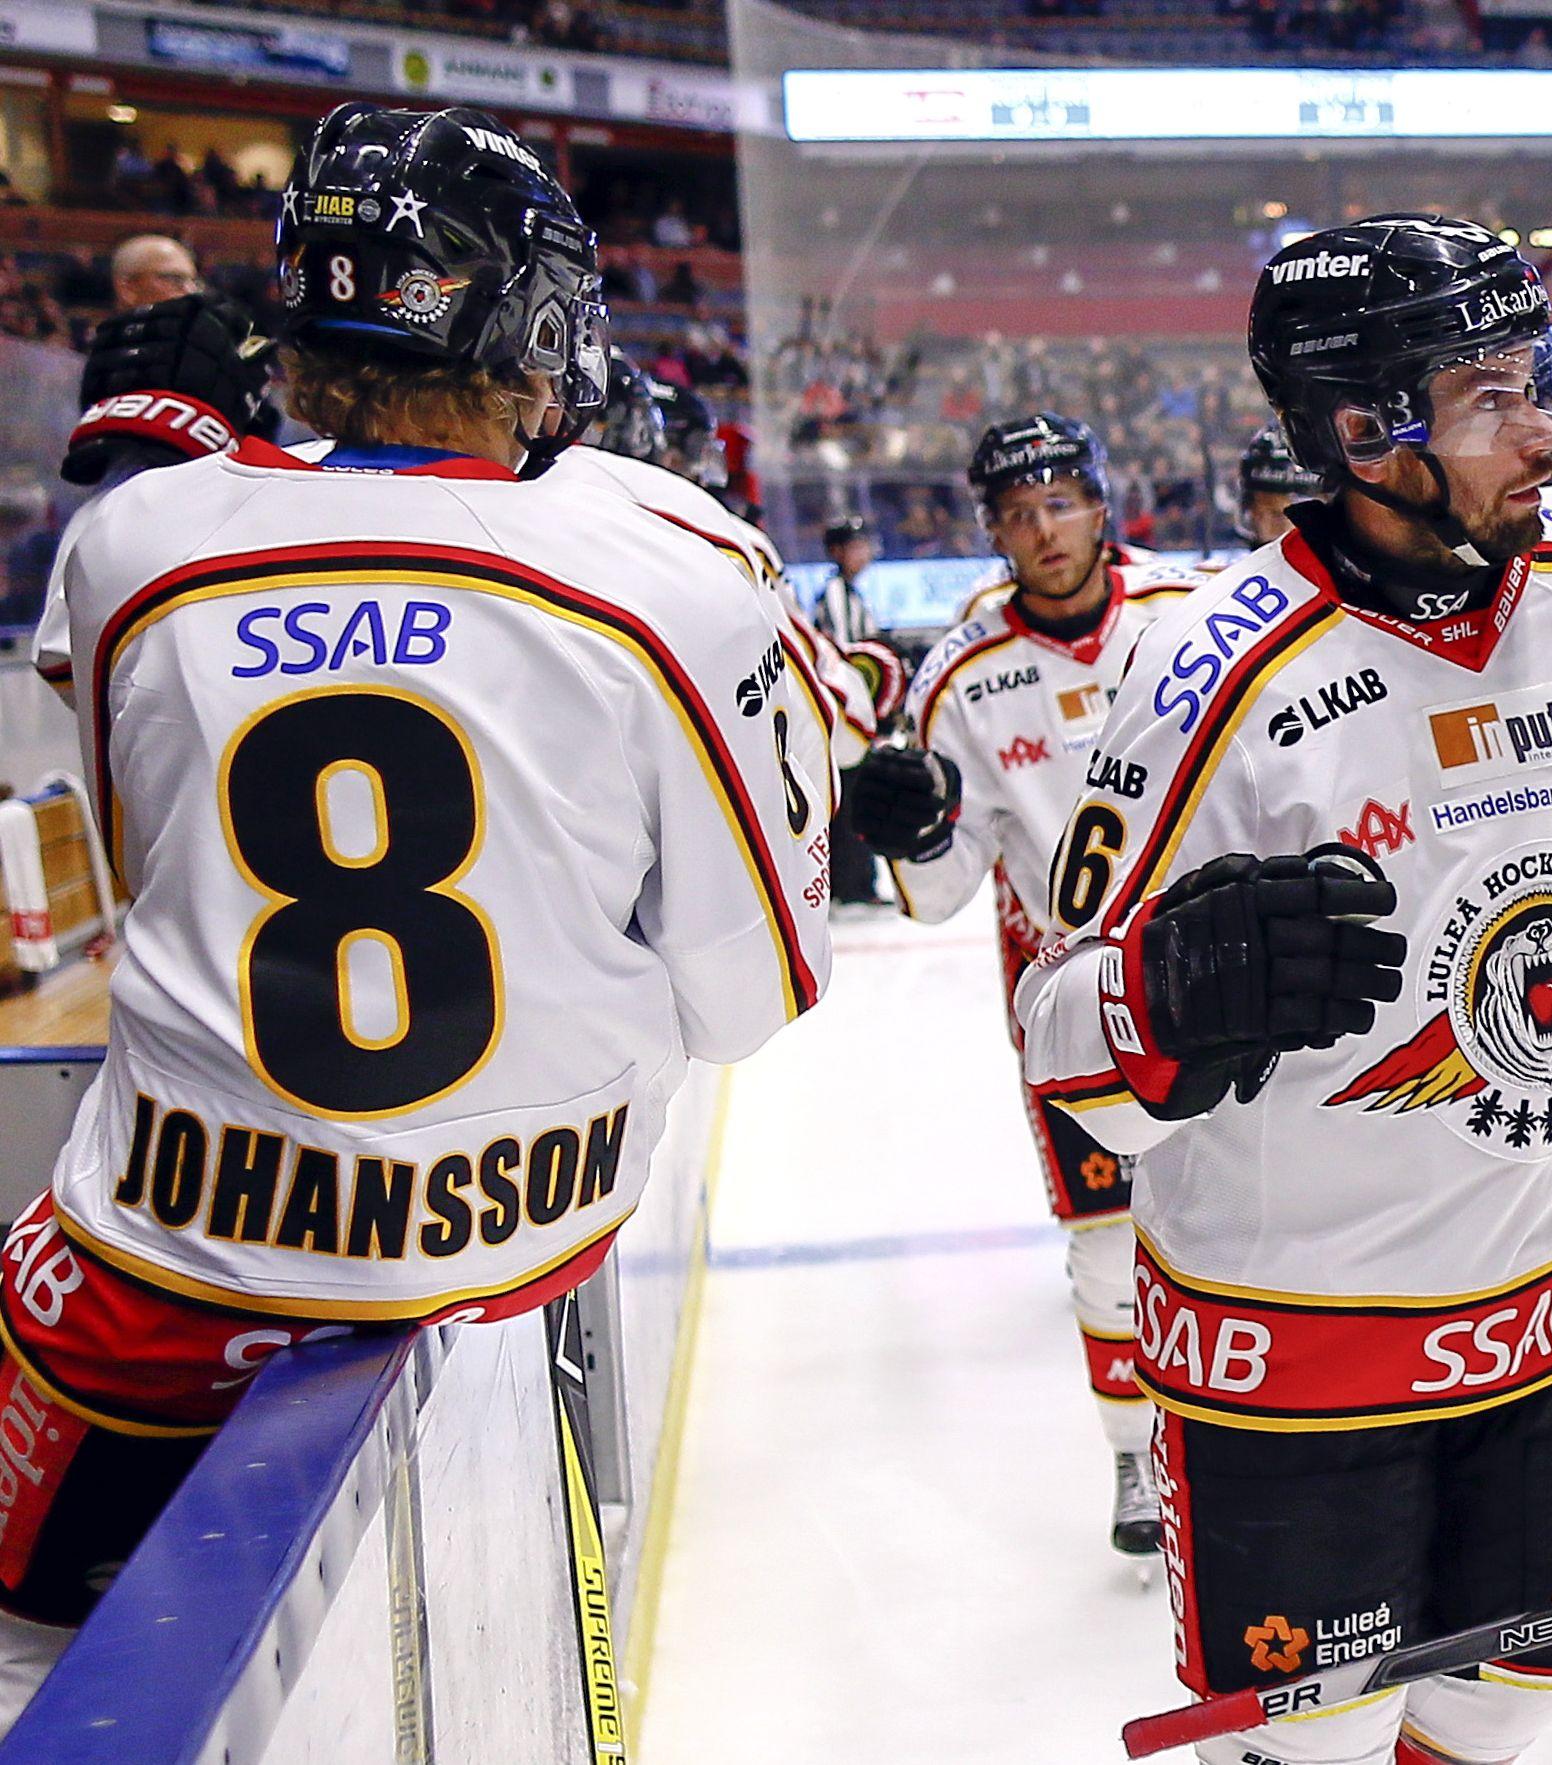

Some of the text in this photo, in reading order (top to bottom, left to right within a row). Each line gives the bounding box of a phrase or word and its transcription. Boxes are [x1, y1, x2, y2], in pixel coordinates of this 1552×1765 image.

[314, 195, 354, 216] JIAB
[330, 256, 355, 301] 8
[1271, 250, 1371, 286] vinter.
[232, 599, 452, 678] SSAB
[760, 640, 786, 702] LKA
[1154, 574, 1288, 733] SSAB
[1440, 621, 1479, 643] SHL
[1298, 667, 1389, 731] LKAB
[773, 705, 816, 839] 8
[217, 683, 506, 1120] 8
[1048, 800, 1128, 932] 6
[1427, 896, 1482, 1002] LULEÅ
[116, 1092, 631, 1262] JOHANSSON
[1134, 1264, 1271, 1394] SSAB
[581, 1560, 621, 1738] SUPREME
[1316, 1601, 1391, 1641] Luleå
